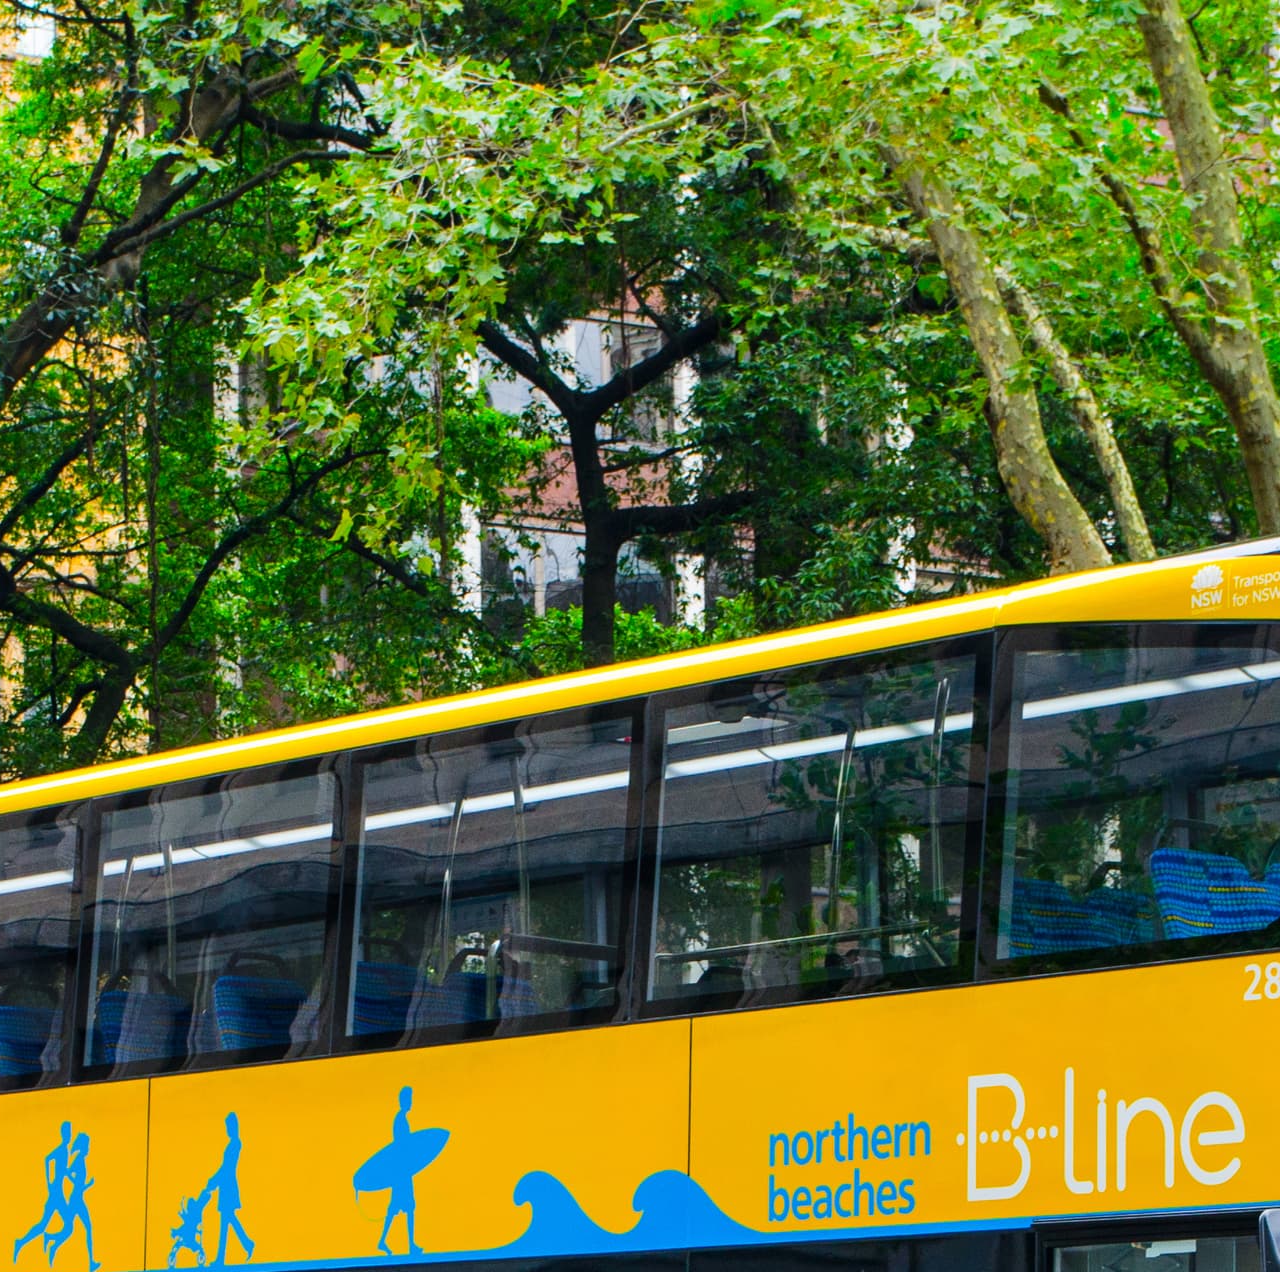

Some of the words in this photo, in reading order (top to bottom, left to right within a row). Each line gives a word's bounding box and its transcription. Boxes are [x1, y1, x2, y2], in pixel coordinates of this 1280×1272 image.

[1191, 590, 1223, 609] NSW
[1232, 592, 1248, 607] for
[768, 1112, 931, 1167] northern
[768, 1168, 916, 1222] beaches
